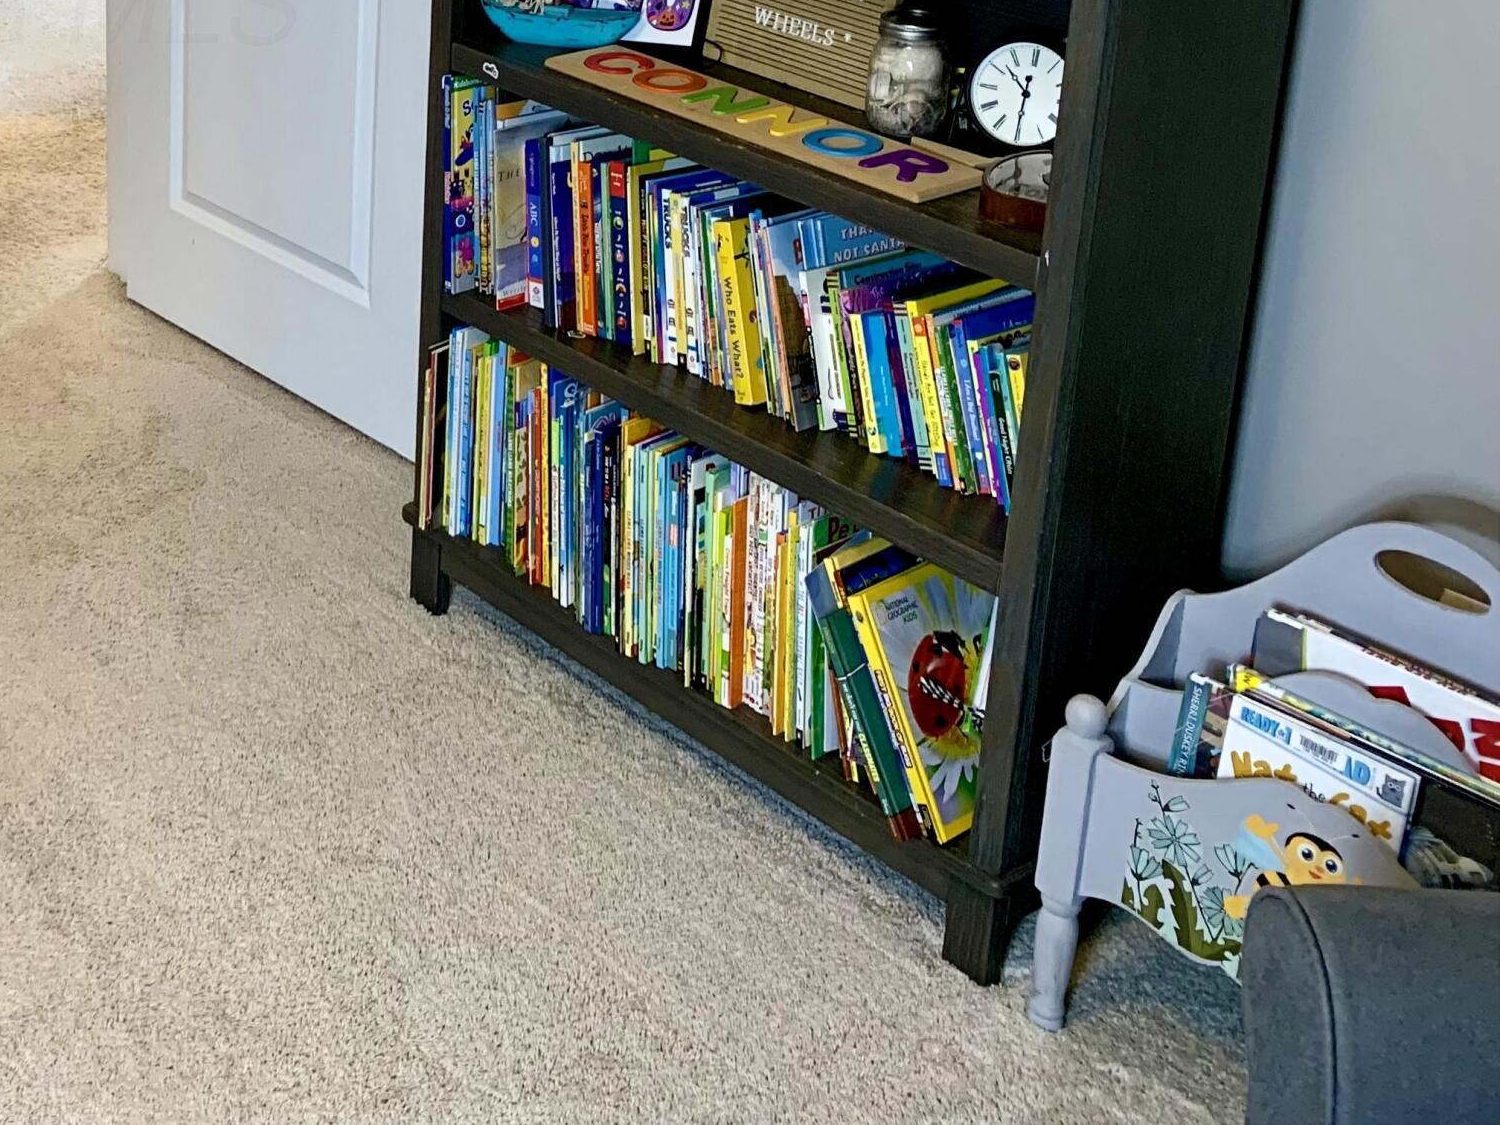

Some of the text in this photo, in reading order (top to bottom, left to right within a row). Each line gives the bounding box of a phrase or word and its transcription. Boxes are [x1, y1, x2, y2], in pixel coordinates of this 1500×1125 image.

[754, 5, 835, 47] WHEELS
[583, 51, 949, 183] CONNOR
[530, 202, 538, 226] ABC
[663, 197, 672, 249] TRUCKS
[681, 205, 690, 257] TRUCKS
[841, 225, 873, 240] THA
[834, 246, 859, 263] NOT
[723, 277, 743, 379] Who Eats What?
[999, 417, 1013, 475] Good Night Ohio
[902, 610, 918, 624] KIDS
[875, 670, 890, 694] FIRST
[887, 708, 900, 731] BOOK
[1185, 685, 1203, 720] SHERRI
[857, 733, 880, 783] CLASSMATES
[1178, 720, 1197, 756] DUSKEY
[1303, 783, 1327, 803] the
